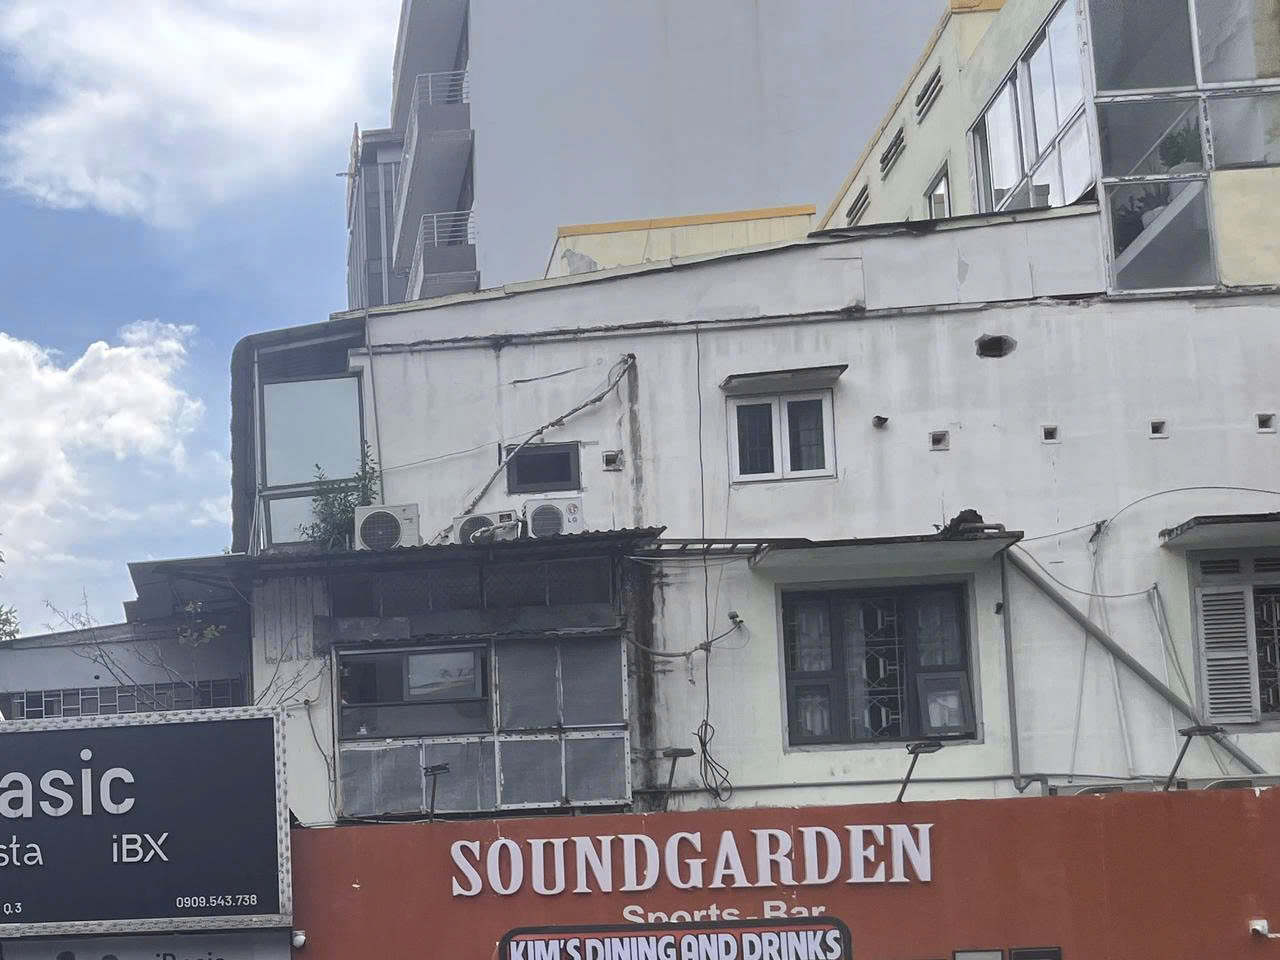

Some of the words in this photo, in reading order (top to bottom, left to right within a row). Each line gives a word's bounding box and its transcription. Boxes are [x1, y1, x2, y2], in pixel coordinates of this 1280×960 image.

[111, 832, 169, 864] iBX
[450, 822, 935, 898] SOUNDGARDEN
[176, 894, 258, 908] 0909.543.738
